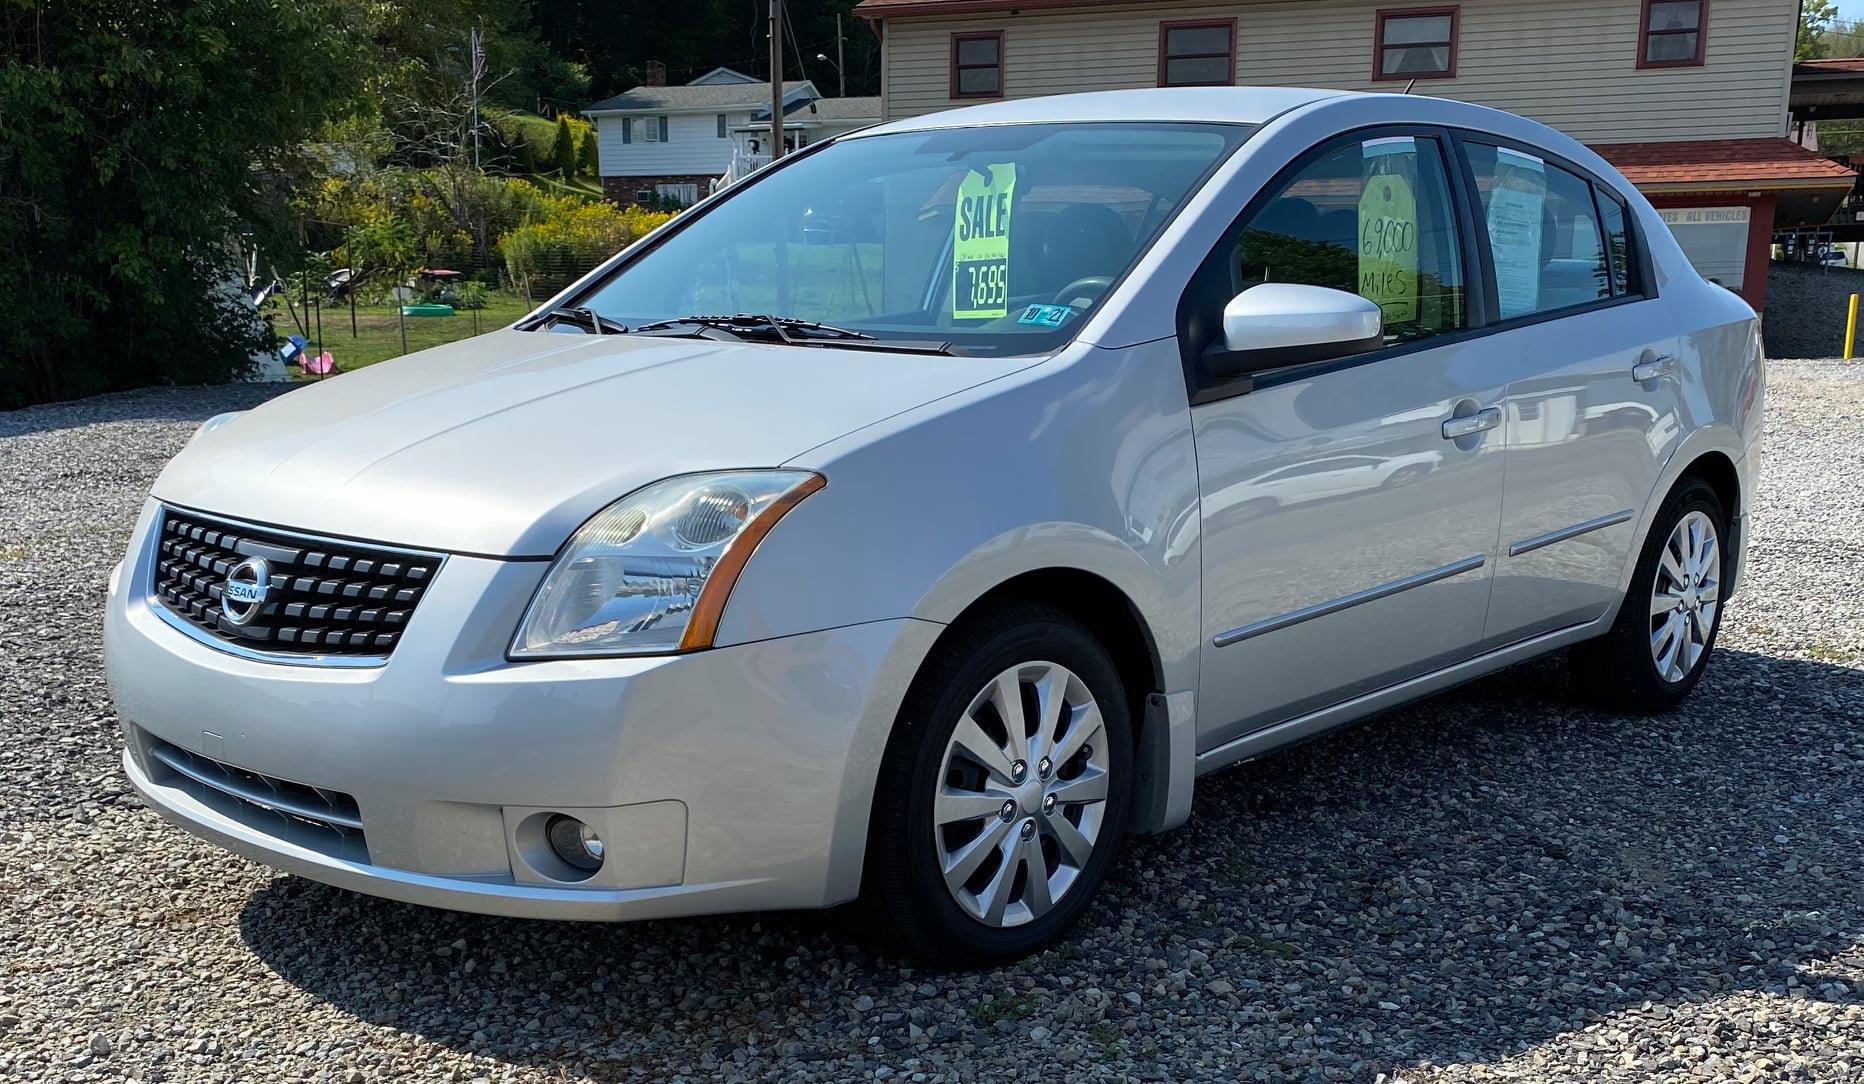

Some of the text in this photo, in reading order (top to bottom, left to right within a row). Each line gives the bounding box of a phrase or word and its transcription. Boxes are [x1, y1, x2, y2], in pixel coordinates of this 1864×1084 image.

[959, 193, 1008, 242] SALE
[1686, 211, 1703, 222] ALL
[1705, 209, 1748, 222] VEHICLES
[968, 264, 1006, 309] 7,695
[1047, 308, 1066, 321] 21
[227, 585, 258, 599] SSAN
